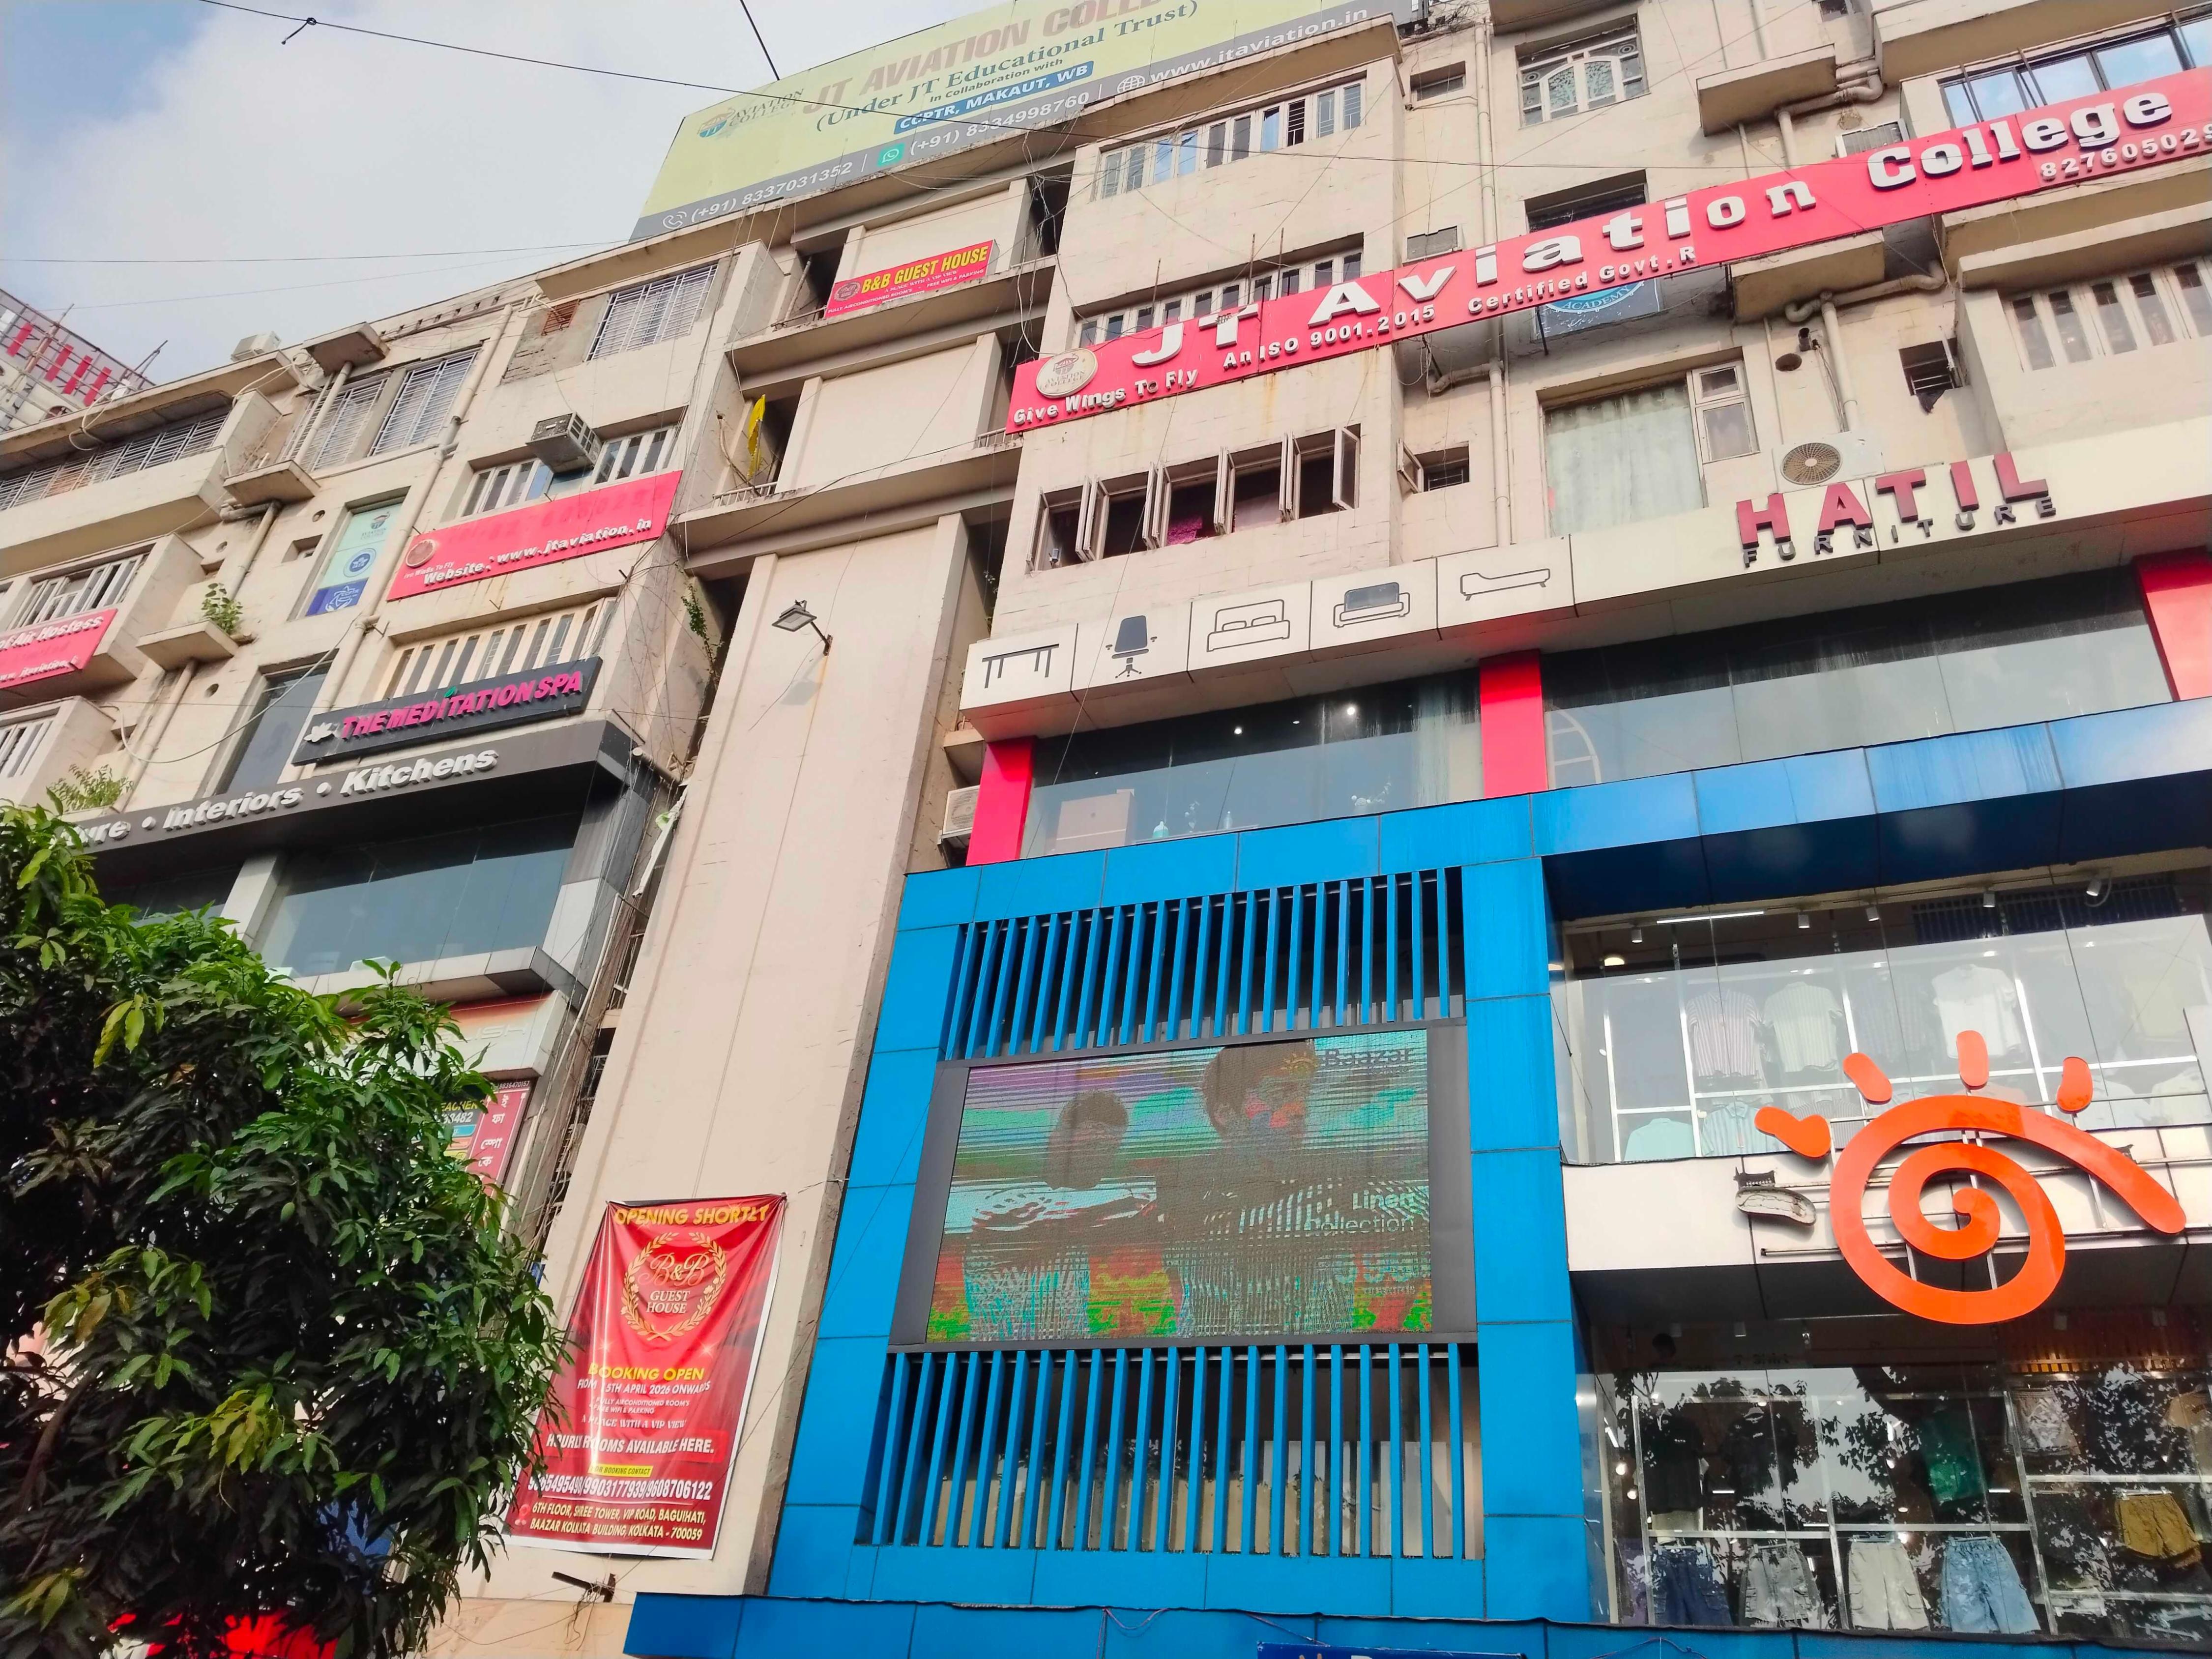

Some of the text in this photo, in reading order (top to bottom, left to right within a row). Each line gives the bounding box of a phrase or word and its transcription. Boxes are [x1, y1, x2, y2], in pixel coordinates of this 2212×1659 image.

[816, 0, 1198, 132] (Under JT Educational Trust)
[816, 77, 853, 115] JT
[859, 19, 1031, 96] AVIATION
[945, 70, 1030, 98] Collaboration
[1036, 57, 1063, 72] with
[900, 64, 1088, 129] CCPTR, MAKAUT, WB
[909, 91, 1090, 156] (+91) 8334998760
[691, 161, 853, 223] (+91) 8337031352
[1132, 91, 2173, 367] JT Aviation College
[861, 273, 891, 294] B&B
[894, 260, 939, 285] GUEST
[940, 245, 989, 273] HOUSE
[959, 268, 984, 280] PARKING
[844, 294, 889, 309] AIRCONDITIONED
[1561, 285, 1631, 310] ACADEMY
[1223, 350, 1252, 371] An
[1467, 270, 1588, 315] Certified
[1014, 368, 1199, 427] Give Wings To Fly
[1736, 451, 2049, 549] HATIL
[496, 517, 652, 565] www.jtaviation.in
[1742, 496, 2057, 568] FURNITURE
[38, 616, 104, 642] Hostess
[534, 670, 582, 699] SPA
[163, 787, 305, 832] Interiors
[340, 749, 499, 796] Kitchens
[613, 1205, 770, 1226] OPENING SHORTLY
[639, 1252, 711, 1287] B&B
[645, 1302, 688, 1314] HOUSE
[649, 1290, 691, 1302] GUEST
[587, 1364, 705, 1381] BOOKING OPEN
[623, 1383, 647, 1395] APRIL
[648, 1384, 670, 1395] 2026
[671, 1380, 712, 1395] ONWARDS
[615, 1398, 664, 1407] AIRCONDITIONED
[627, 1406, 655, 1415] PARKING
[619, 1418, 640, 1428] WITH
[651, 1419, 666, 1429] VIP
[667, 1418, 687, 1429] VIEW
[546, 1433, 583, 1450] HOURLY
[625, 1438, 679, 1455] AVAILABLE
[678, 1437, 714, 1454] HERE.
[604, 1466, 627, 1475] BOOKING
[627, 1467, 652, 1476] CONTACT
[532, 1502, 706, 1526] 6TH FLOOR, SHREE TOWER, VIP ROAD, BAGUIHATI,
[529, 1517, 560, 1532] BAAZAR
[560, 1520, 591, 1535] KOLKATA
[591, 1522, 627, 1539] BUILDING,
[627, 1524, 664, 1539] KOLKATA
[670, 1527, 703, 1542] 700059
